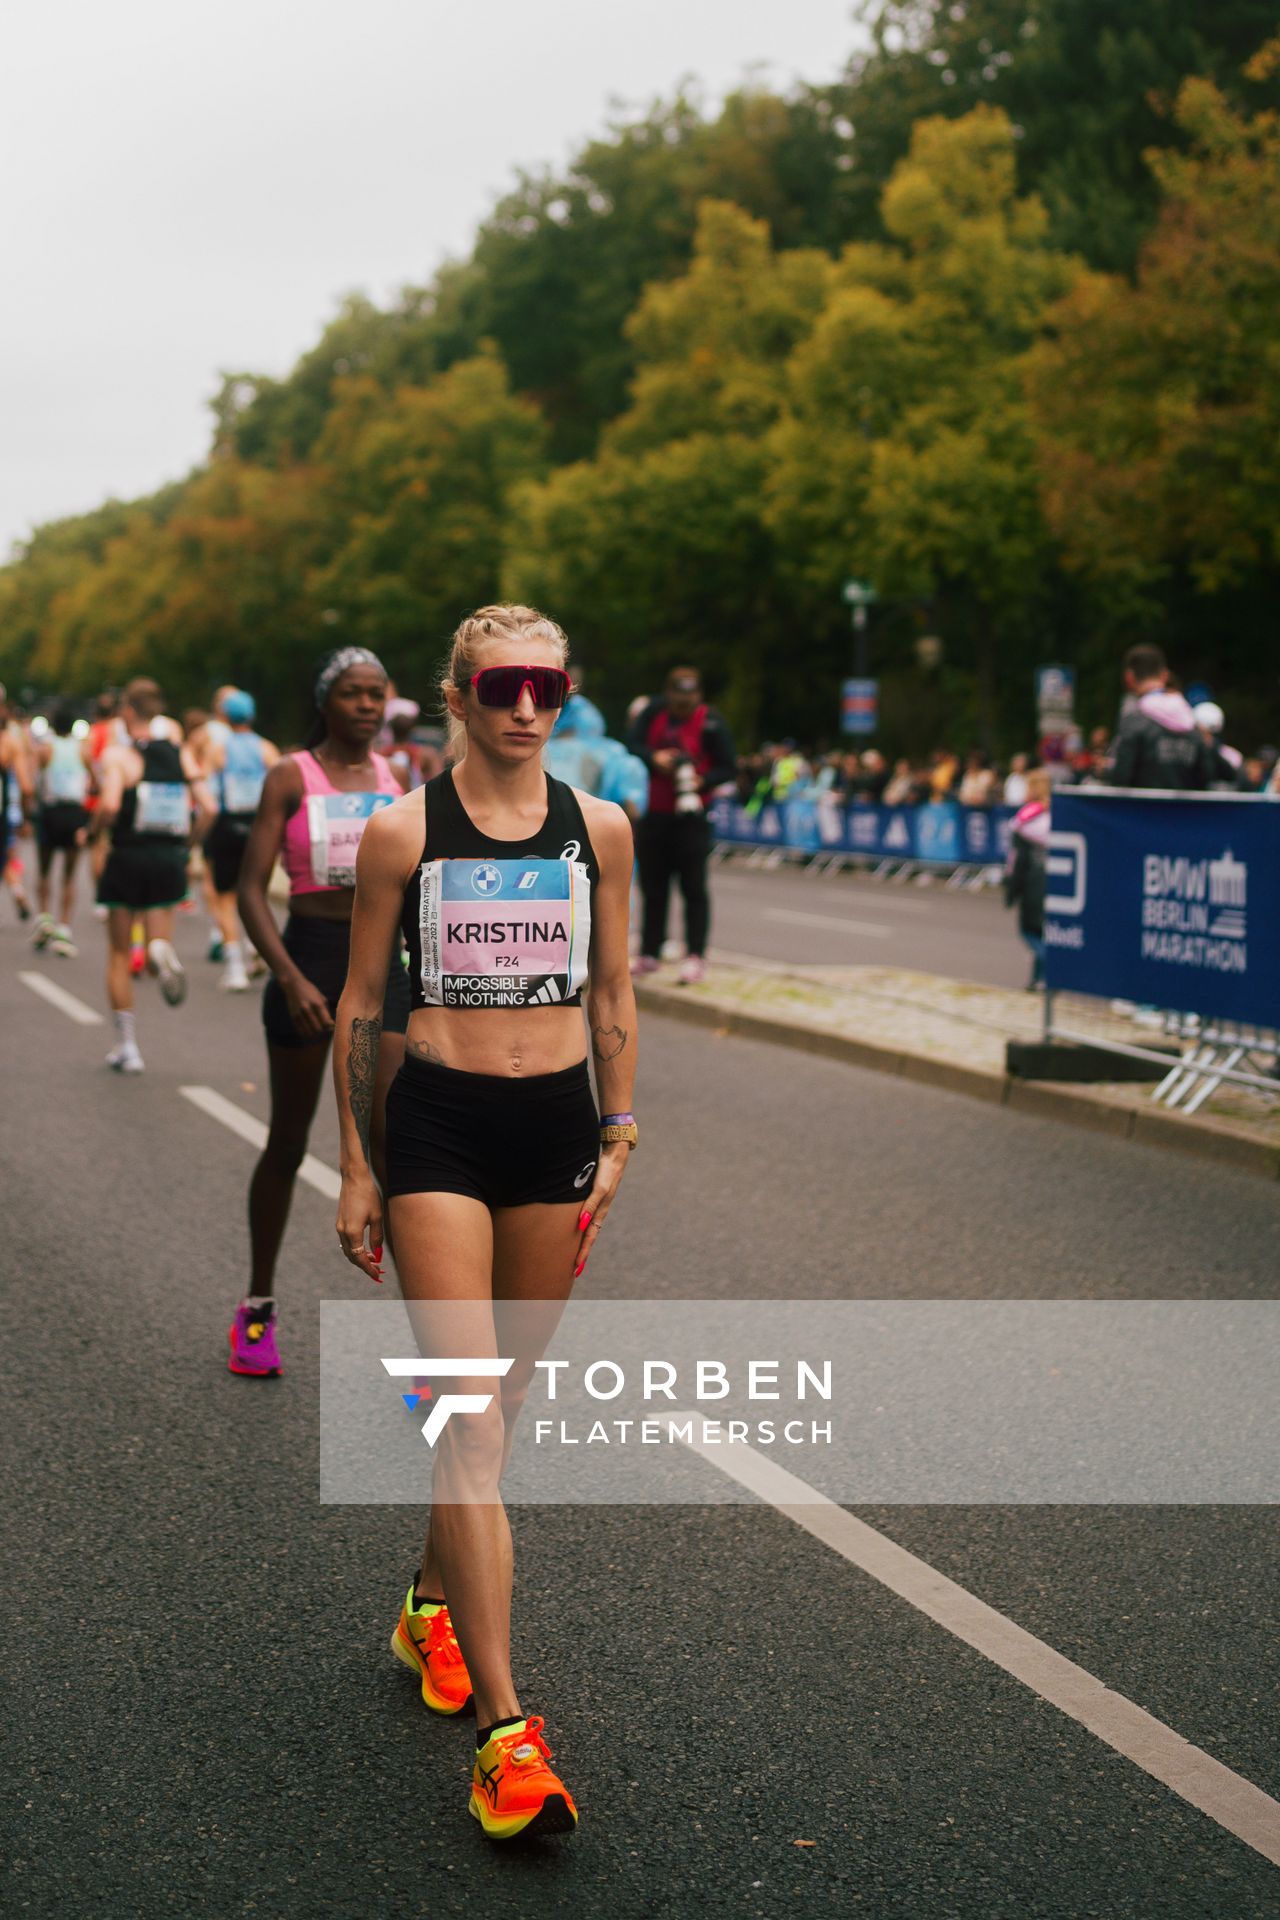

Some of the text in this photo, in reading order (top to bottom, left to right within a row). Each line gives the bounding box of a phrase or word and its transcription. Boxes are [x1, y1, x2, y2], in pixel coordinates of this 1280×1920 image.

[1143, 854, 1208, 900] BMW
[423, 876, 431, 955] BERLIN-MARATHON
[1142, 898, 1208, 934] BERLIN
[447, 922, 568, 944] KRISTINA
[432, 941, 440, 979] September
[495, 956, 519, 967] F24
[1141, 931, 1247, 973] MARATHON
[423, 957, 431, 977] BMW
[444, 977, 528, 990] IMPOSSIBLE
[445, 992, 525, 1005] IS NOTHING
